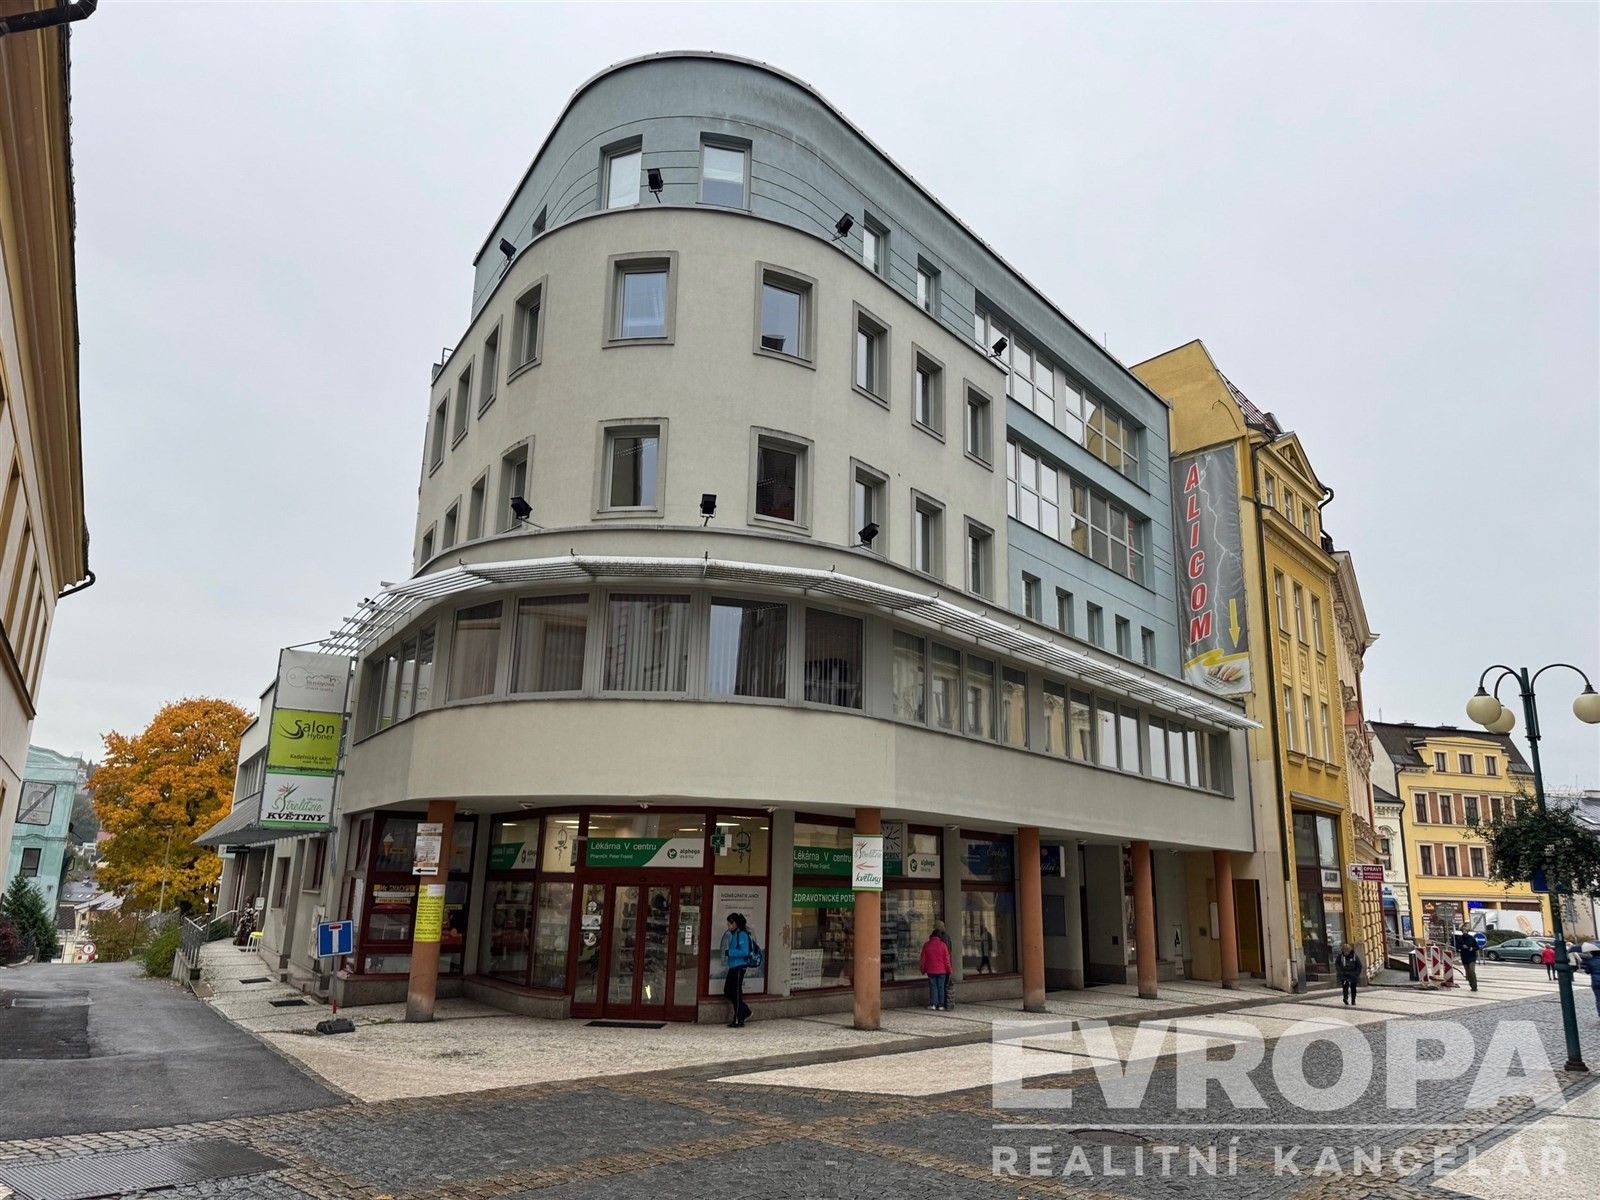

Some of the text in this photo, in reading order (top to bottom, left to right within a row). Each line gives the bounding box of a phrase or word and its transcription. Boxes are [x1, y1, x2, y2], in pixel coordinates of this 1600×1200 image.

[1184, 463, 1212, 645] ALICOM
[290, 719, 335, 739] Salon
[307, 732, 333, 740] Hybner
[266, 811, 326, 821] KVĚTINY
[591, 842, 657, 851] Lékárna V centru
[793, 851, 852, 863] Lékárna V centru
[856, 872, 881, 884] květiny
[794, 892, 839, 903] ZDRAVOTNICKÉ
